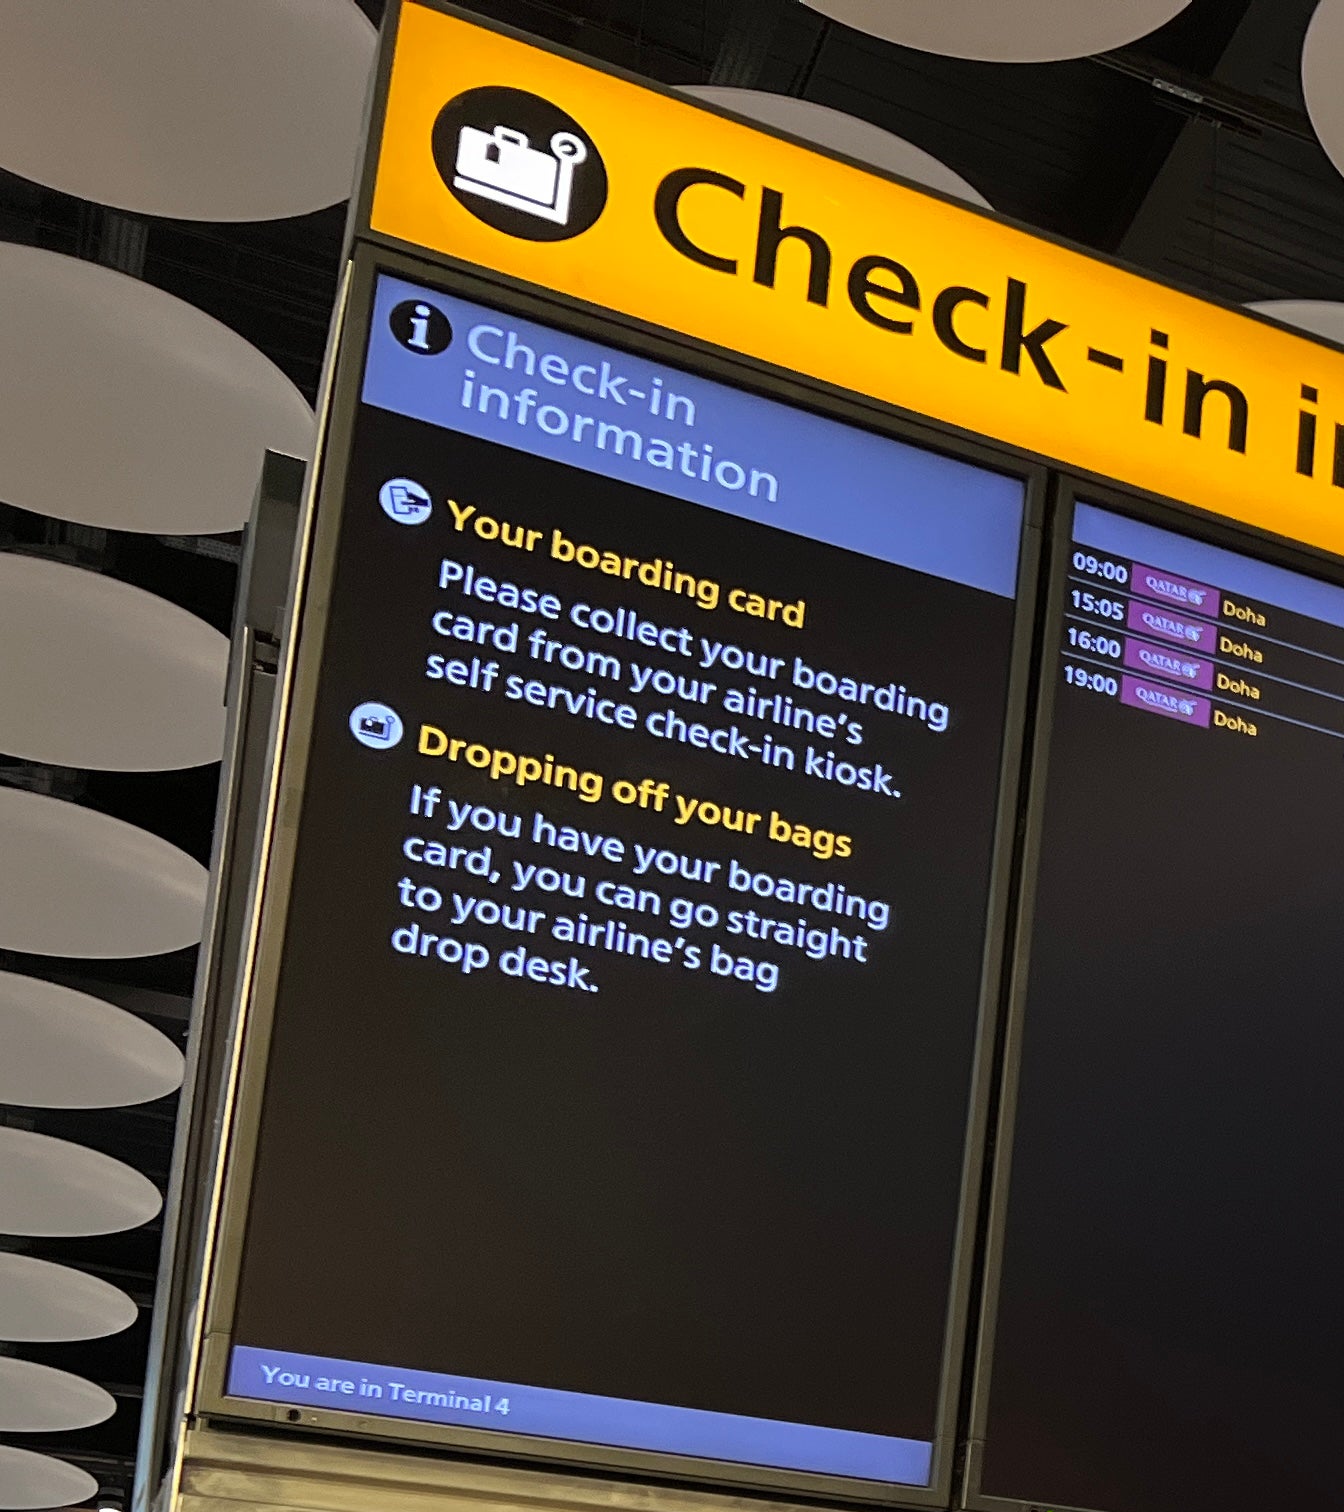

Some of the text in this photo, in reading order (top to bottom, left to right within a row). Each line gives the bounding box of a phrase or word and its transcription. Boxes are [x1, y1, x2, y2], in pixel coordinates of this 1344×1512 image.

[653, 166, 1251, 456] Check-in
[467, 324, 698, 427] Check-in
[460, 369, 780, 503] information
[447, 500, 806, 629] Your boarding card
[1072, 551, 1128, 584] 09:00
[1146, 576, 1187, 599] QATAR
[1071, 589, 1124, 621] 15:05
[1142, 612, 1184, 635] QATAR
[1222, 600, 1266, 627] Doha
[432, 607, 518, 654] card
[529, 630, 621, 680] from
[630, 660, 718, 704] your
[439, 559, 949, 733] Please collect your boarding
[1068, 627, 1121, 658] 16:00
[1139, 649, 1181, 671] QATAR
[1220, 636, 1264, 664] Doha
[1064, 664, 1118, 696] 19:00
[1136, 686, 1178, 709] QATAR
[1217, 673, 1260, 700] Doha
[426, 648, 902, 798] self service check-in kiosk.
[1214, 710, 1258, 737] Doha
[418, 724, 852, 859] Dropping off your bags
[410, 784, 890, 930] If you have your boarding
[403, 835, 868, 963] card, you can go straight
[391, 922, 599, 993] drop desk.
[398, 876, 442, 911] to
[451, 892, 544, 934] your
[711, 944, 779, 993] bag
[261, 1364, 511, 1417] You are in Terminal 4
